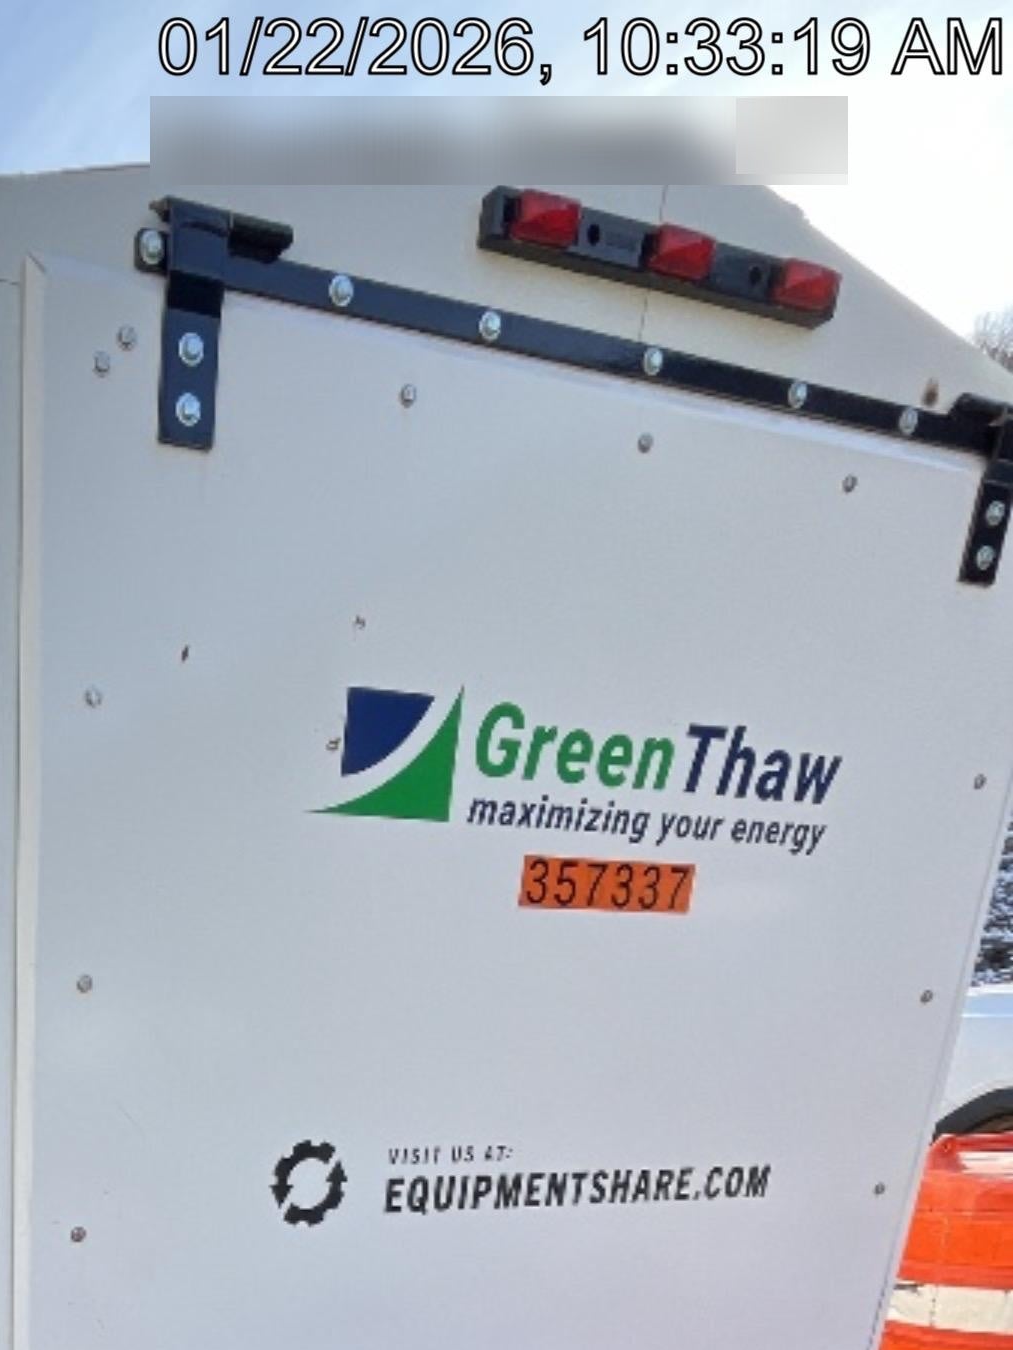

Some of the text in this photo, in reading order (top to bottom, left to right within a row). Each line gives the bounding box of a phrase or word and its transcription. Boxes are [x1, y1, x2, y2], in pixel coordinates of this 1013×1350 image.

[466, 794, 828, 856] maximizing your energy
[525, 857, 690, 910] 357337
[388, 1147, 441, 1165] VISIT
[451, 1145, 476, 1163] US
[384, 1164, 772, 1215] EQUIPMENTSHARE.COM
